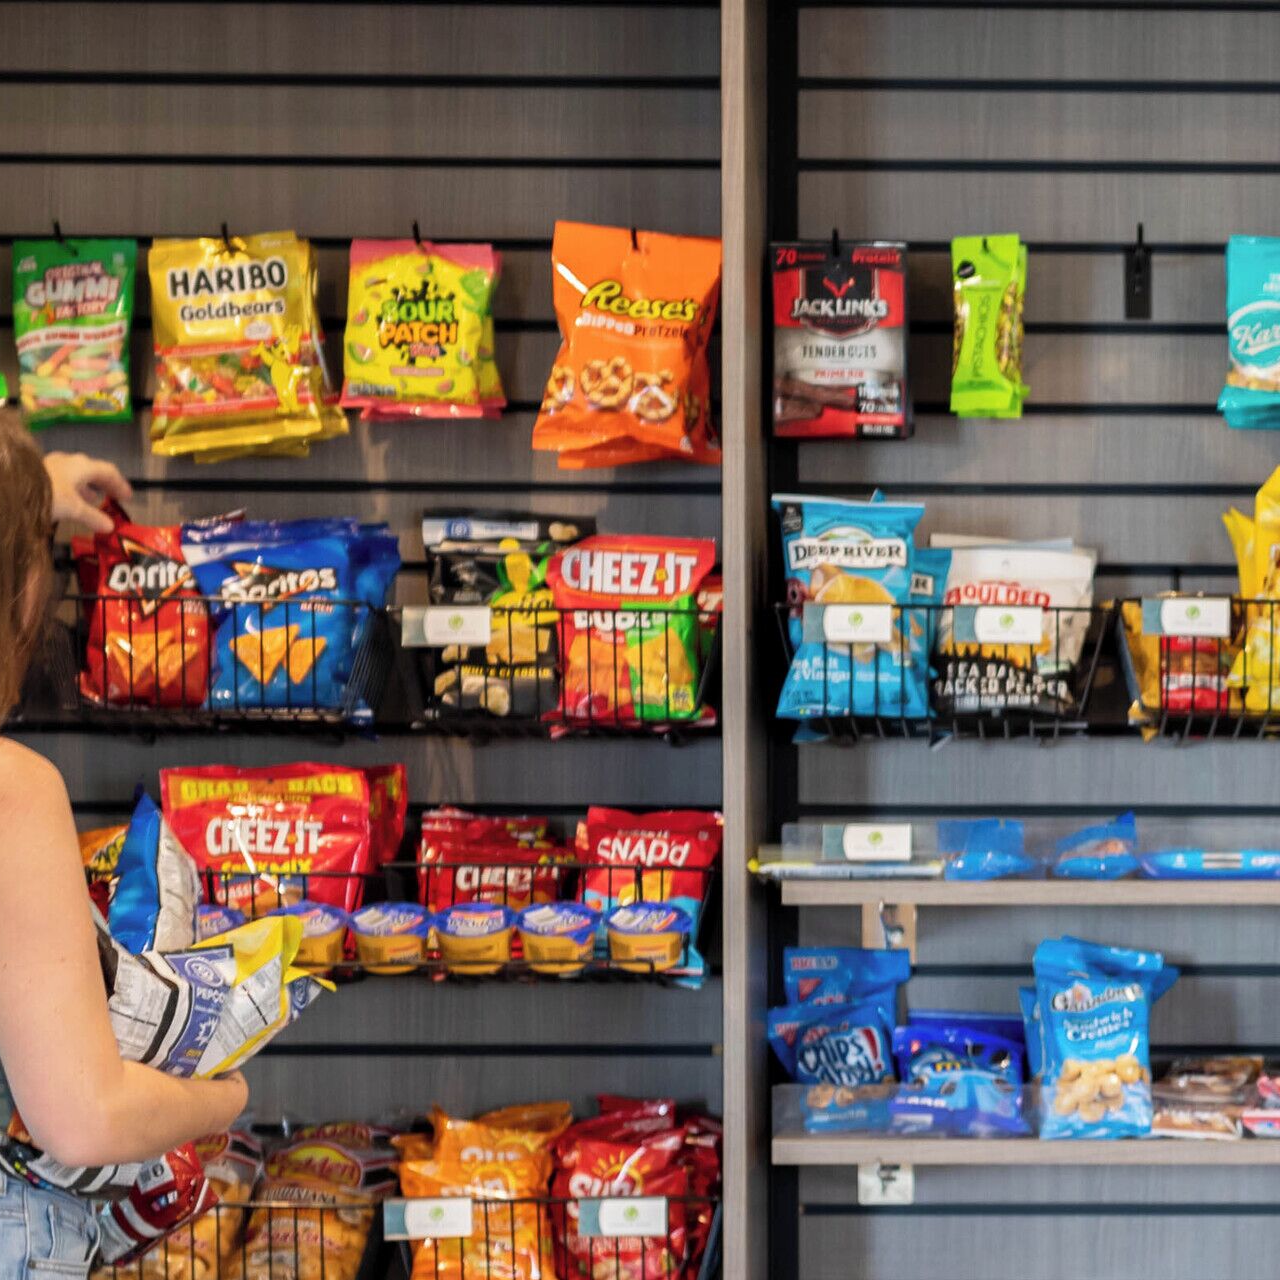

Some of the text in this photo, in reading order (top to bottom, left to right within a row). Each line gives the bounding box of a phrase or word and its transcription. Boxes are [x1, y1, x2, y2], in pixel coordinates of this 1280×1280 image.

[170, 260, 287, 298] HARIBO
[180, 299, 285, 322] Goldbears
[381, 300, 456, 323] SOUR
[792, 298, 837, 318] JACK
[380, 321, 460, 348] PATCH
[793, 543, 903, 562] DEEP RIVER
[798, 1034, 865, 1075] Chips
